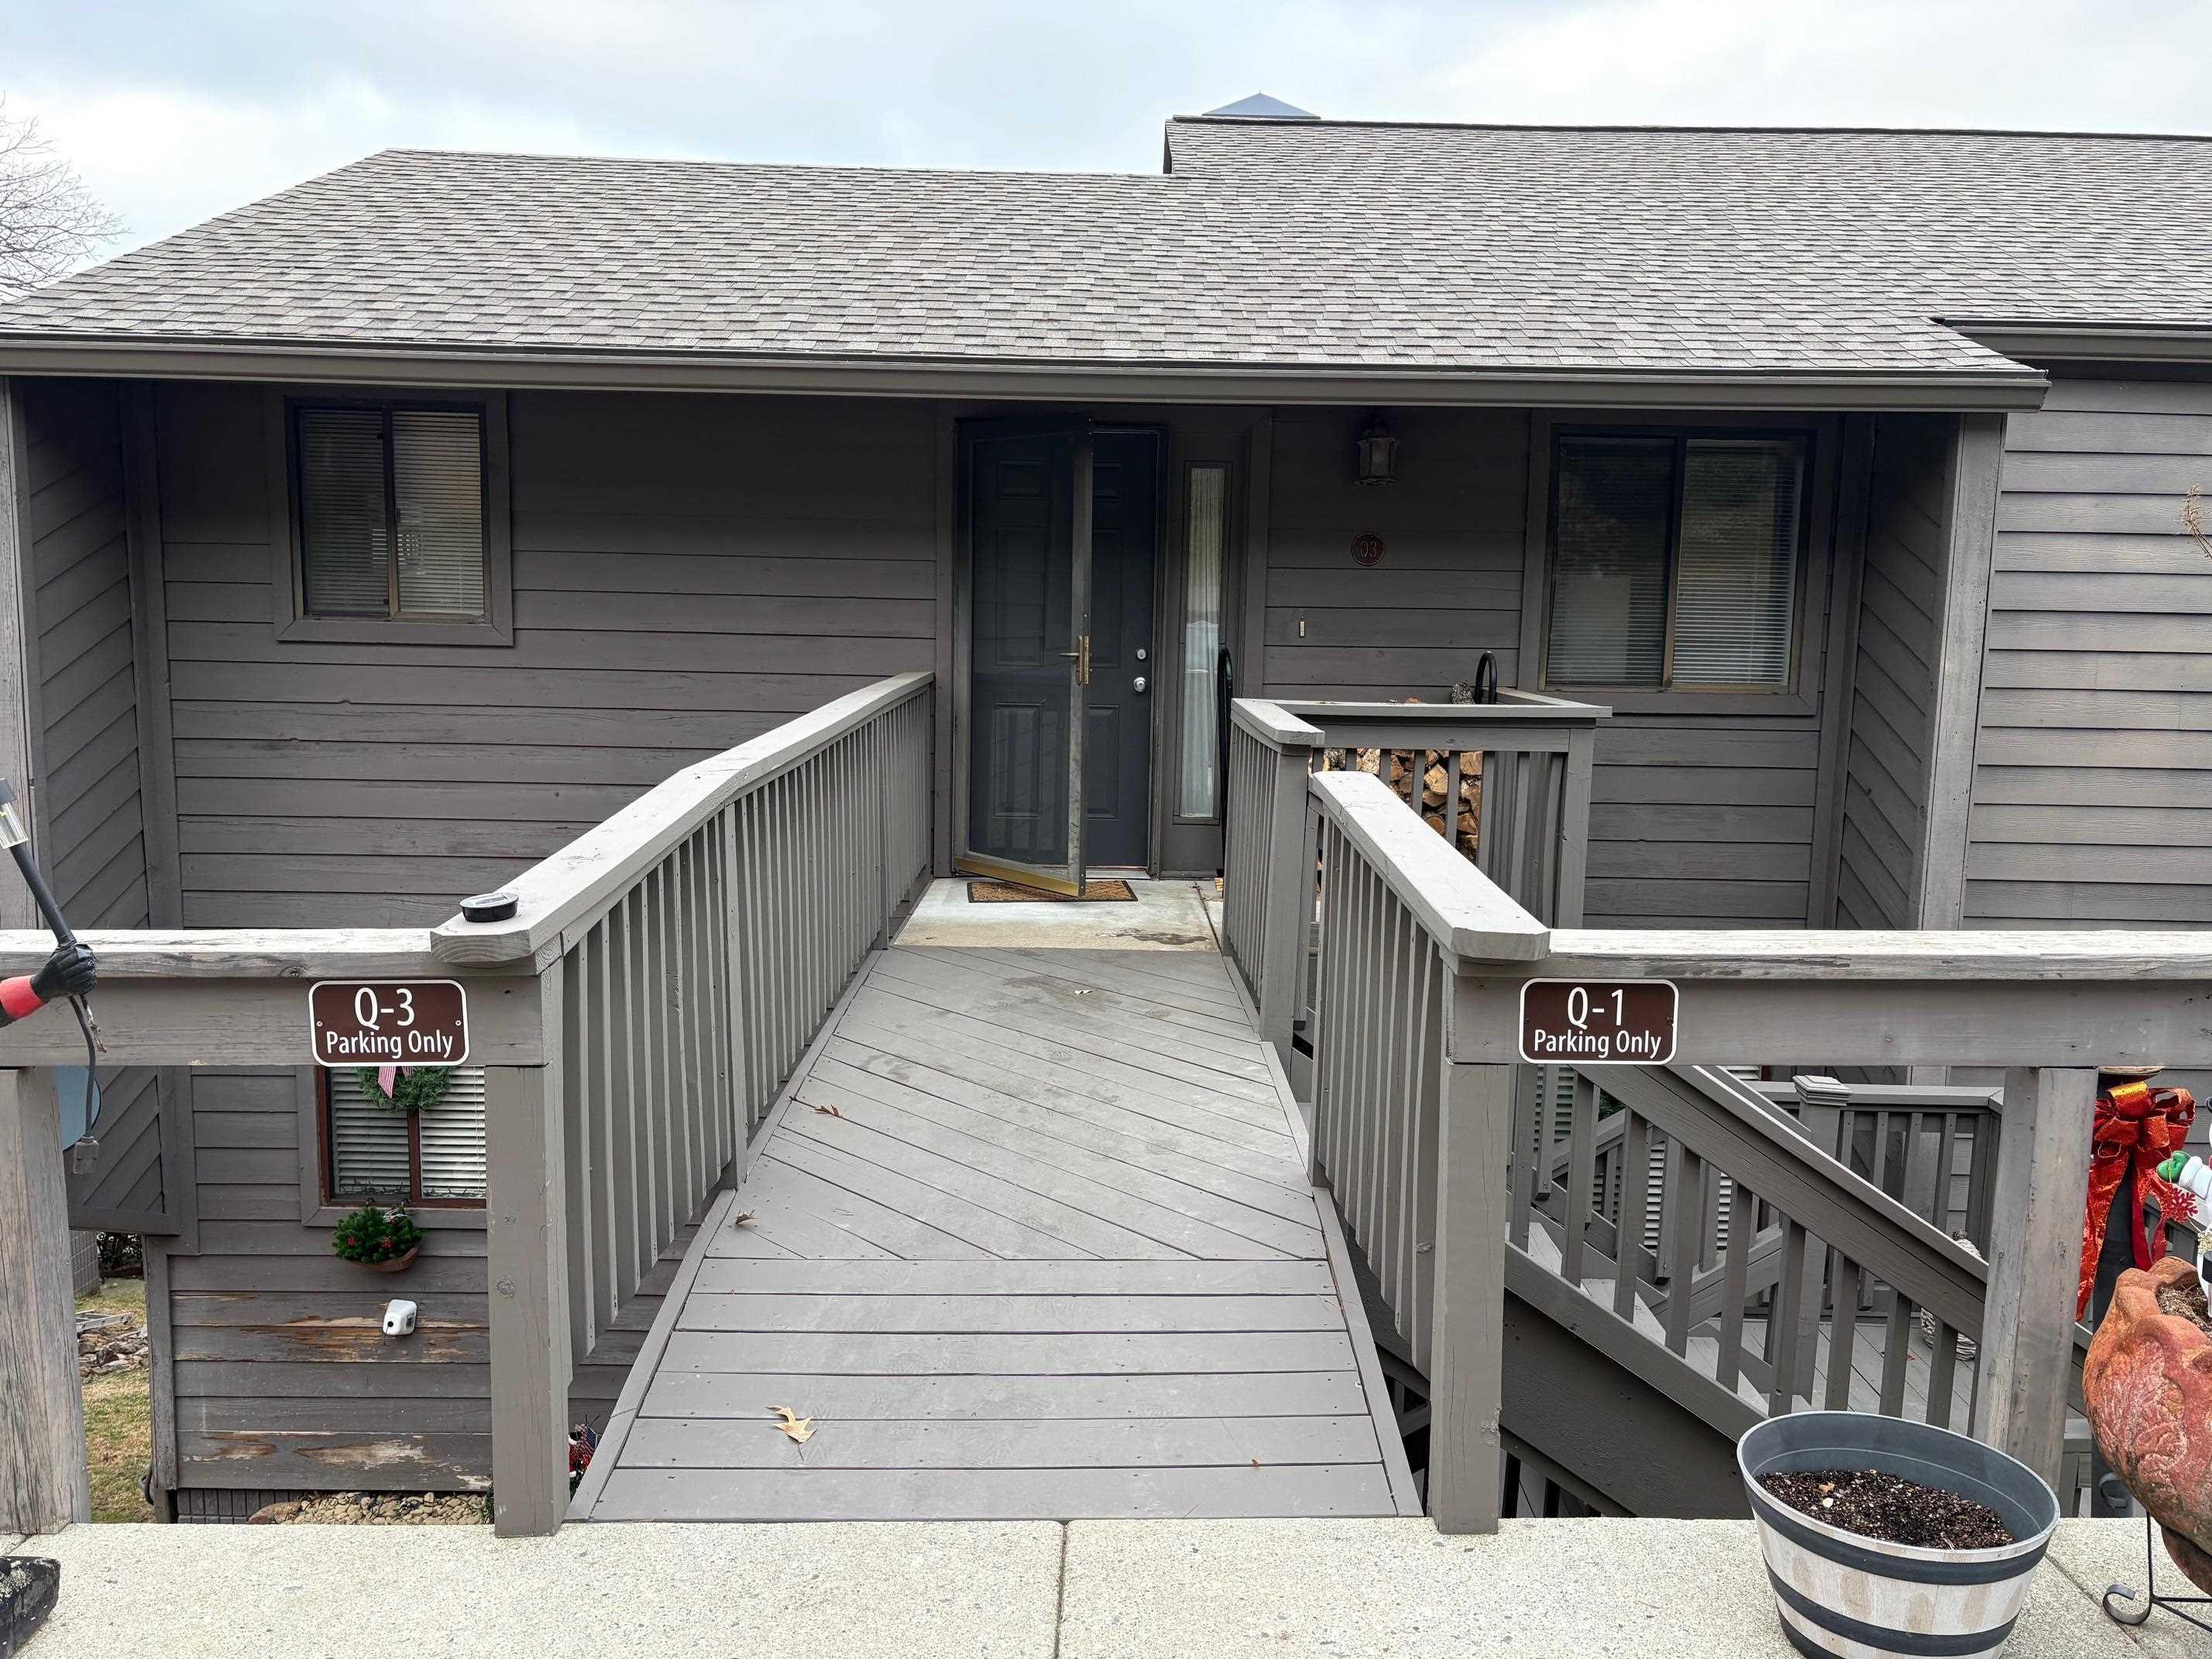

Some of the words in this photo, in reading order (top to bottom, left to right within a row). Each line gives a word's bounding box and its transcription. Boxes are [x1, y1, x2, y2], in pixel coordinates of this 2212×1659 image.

[354, 987, 415, 1031] Q-3
[1567, 987, 1623, 1029] Q-1
[326, 1029, 402, 1059] Parking
[407, 1029, 453, 1059] Only
[1534, 1029, 1609, 1059] Parking
[1616, 1029, 1662, 1060] Only
